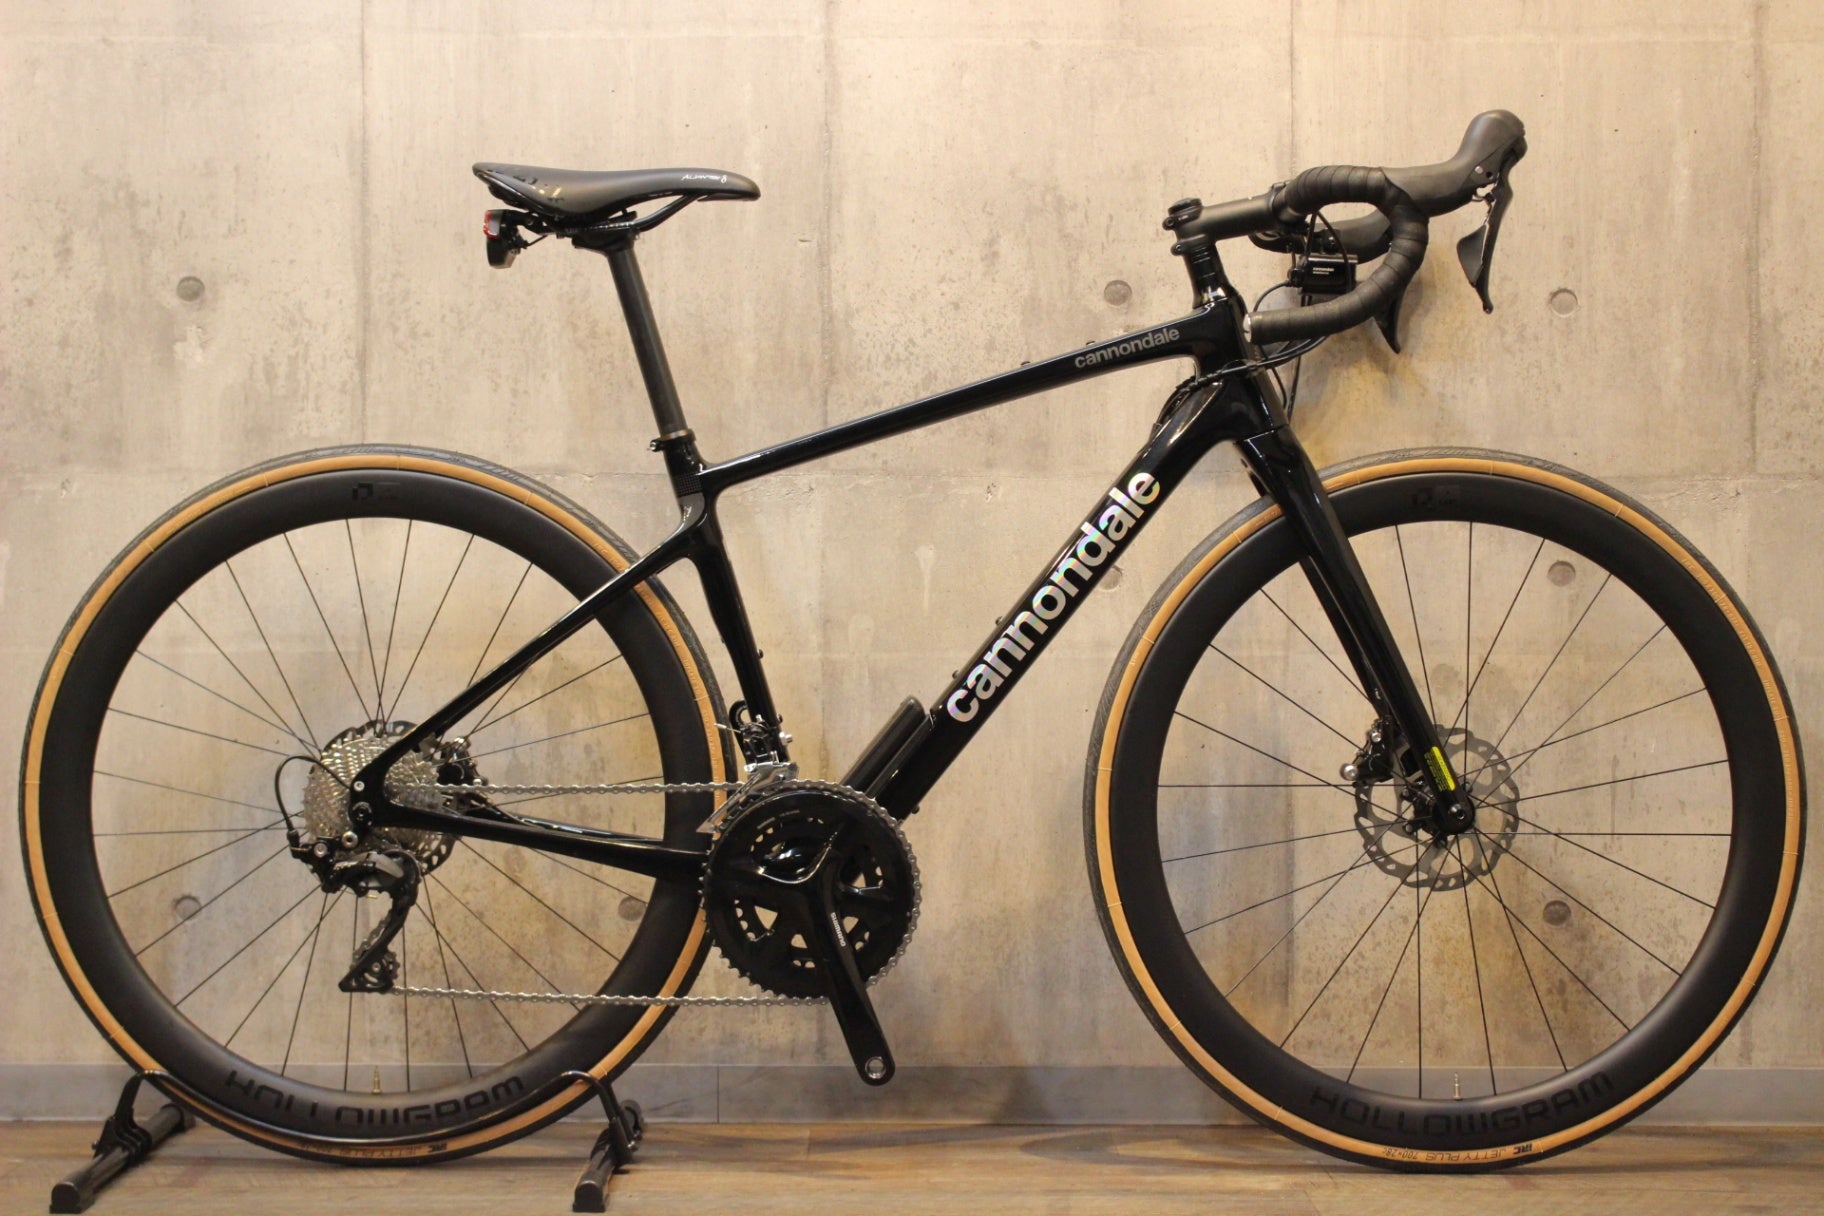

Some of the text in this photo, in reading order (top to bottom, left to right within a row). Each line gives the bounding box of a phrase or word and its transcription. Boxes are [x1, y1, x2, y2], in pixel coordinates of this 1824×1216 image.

[1075, 327, 1180, 369] cannondale
[947, 472, 1161, 722] cannondale
[1310, 1071, 1615, 1137] HOLLOWGRAM
[1425, 1152, 1460, 1161] PLUS
[1464, 1149, 1506, 1161] JETTY
